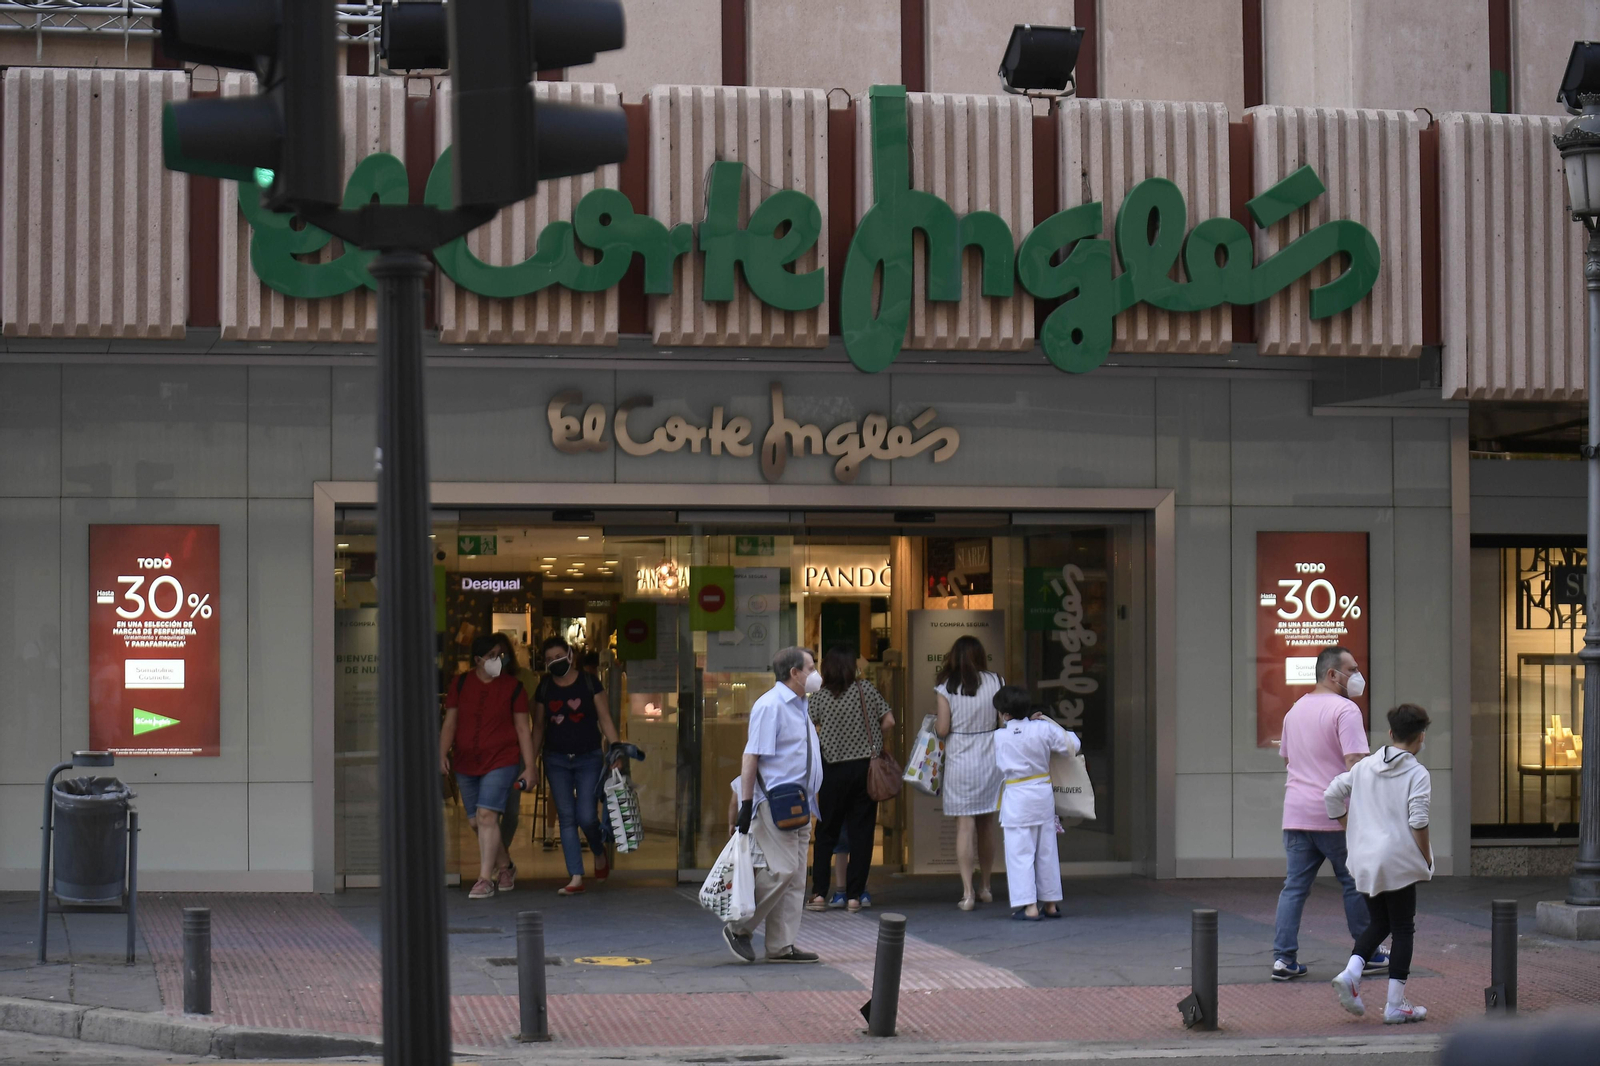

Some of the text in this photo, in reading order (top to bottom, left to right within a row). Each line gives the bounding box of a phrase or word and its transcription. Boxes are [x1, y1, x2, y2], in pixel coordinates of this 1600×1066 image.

[839, 84, 1381, 374] Inglés
[547, 381, 960, 484] El Corte Inglés
[137, 557, 172, 569] TODO
[1296, 562, 1326, 573] TODO
[461, 577, 521, 593] Desigual
[143, 620, 182, 628] SELECCIÓN
[153, 627, 197, 635] PERFUMERÍA
[344, 666, 359, 674] DE
